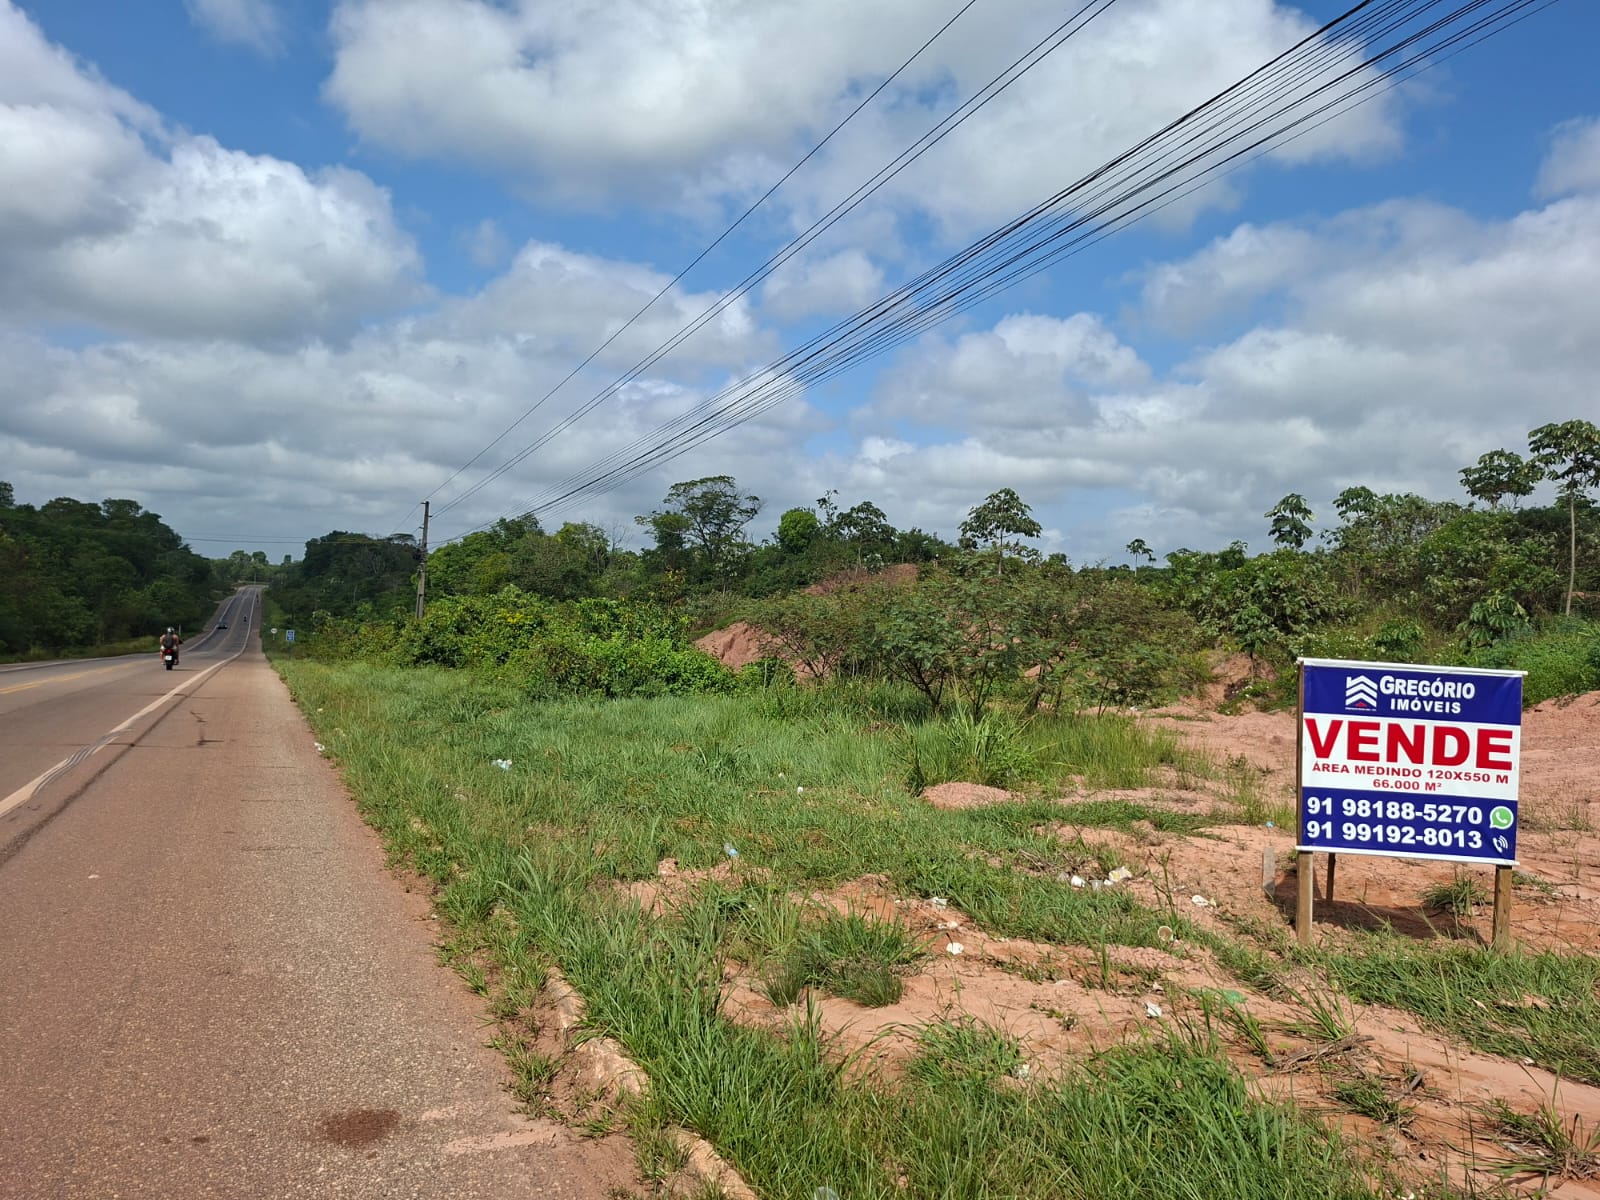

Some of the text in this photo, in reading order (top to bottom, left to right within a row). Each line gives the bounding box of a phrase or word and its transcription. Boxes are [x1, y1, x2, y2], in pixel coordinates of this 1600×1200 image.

[1380, 675, 1475, 699] GREGÓRIO
[1390, 698, 1461, 713] IMÓVEIS
[1304, 718, 1513, 770] VENDE
[1313, 762, 1509, 783] ÁREA MEDINDO 120X550 M
[1373, 779, 1419, 790] 66.000
[1307, 797, 1483, 824] 91 98188-5270
[1307, 821, 1482, 848] 91 99192-8013
